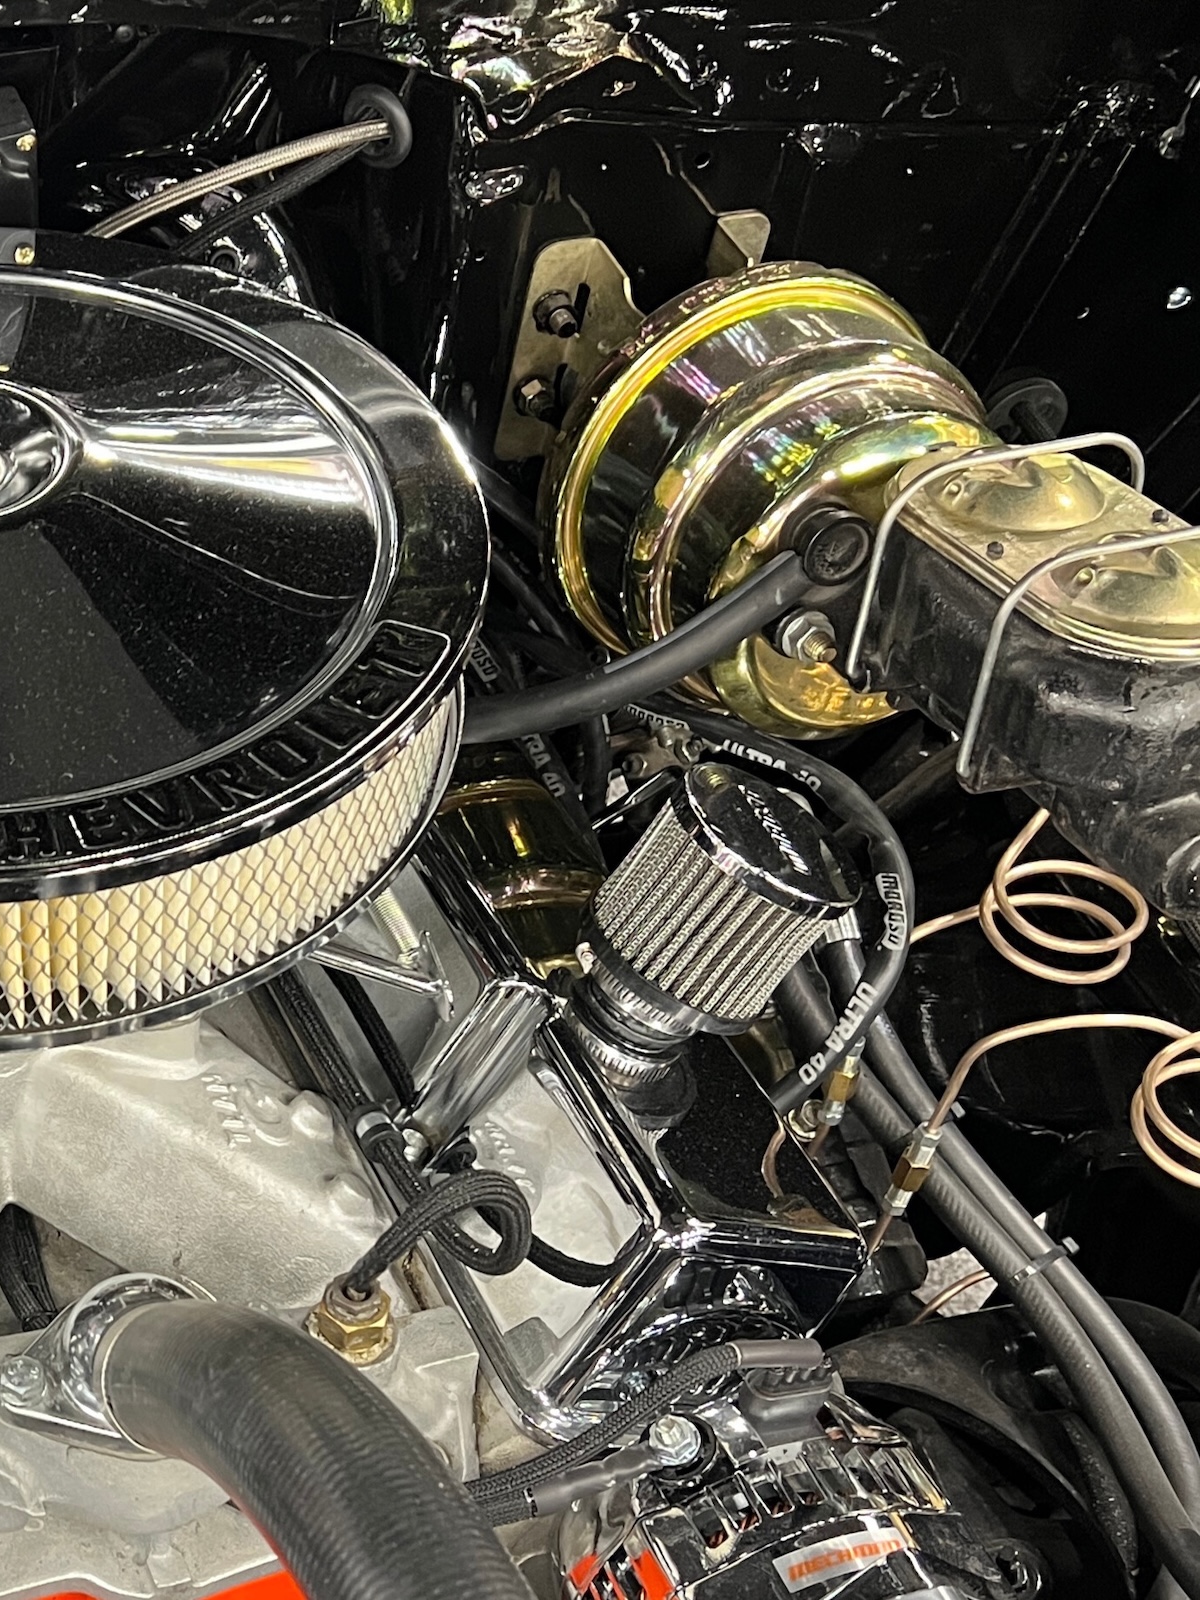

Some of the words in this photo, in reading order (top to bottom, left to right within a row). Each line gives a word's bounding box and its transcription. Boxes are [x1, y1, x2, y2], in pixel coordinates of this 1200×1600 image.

[520, 733, 552, 770] TRA
[875, 873, 907, 950] MOROSO
[824, 981, 879, 1053] ULTRA
[798, 1051, 827, 1086] 40
